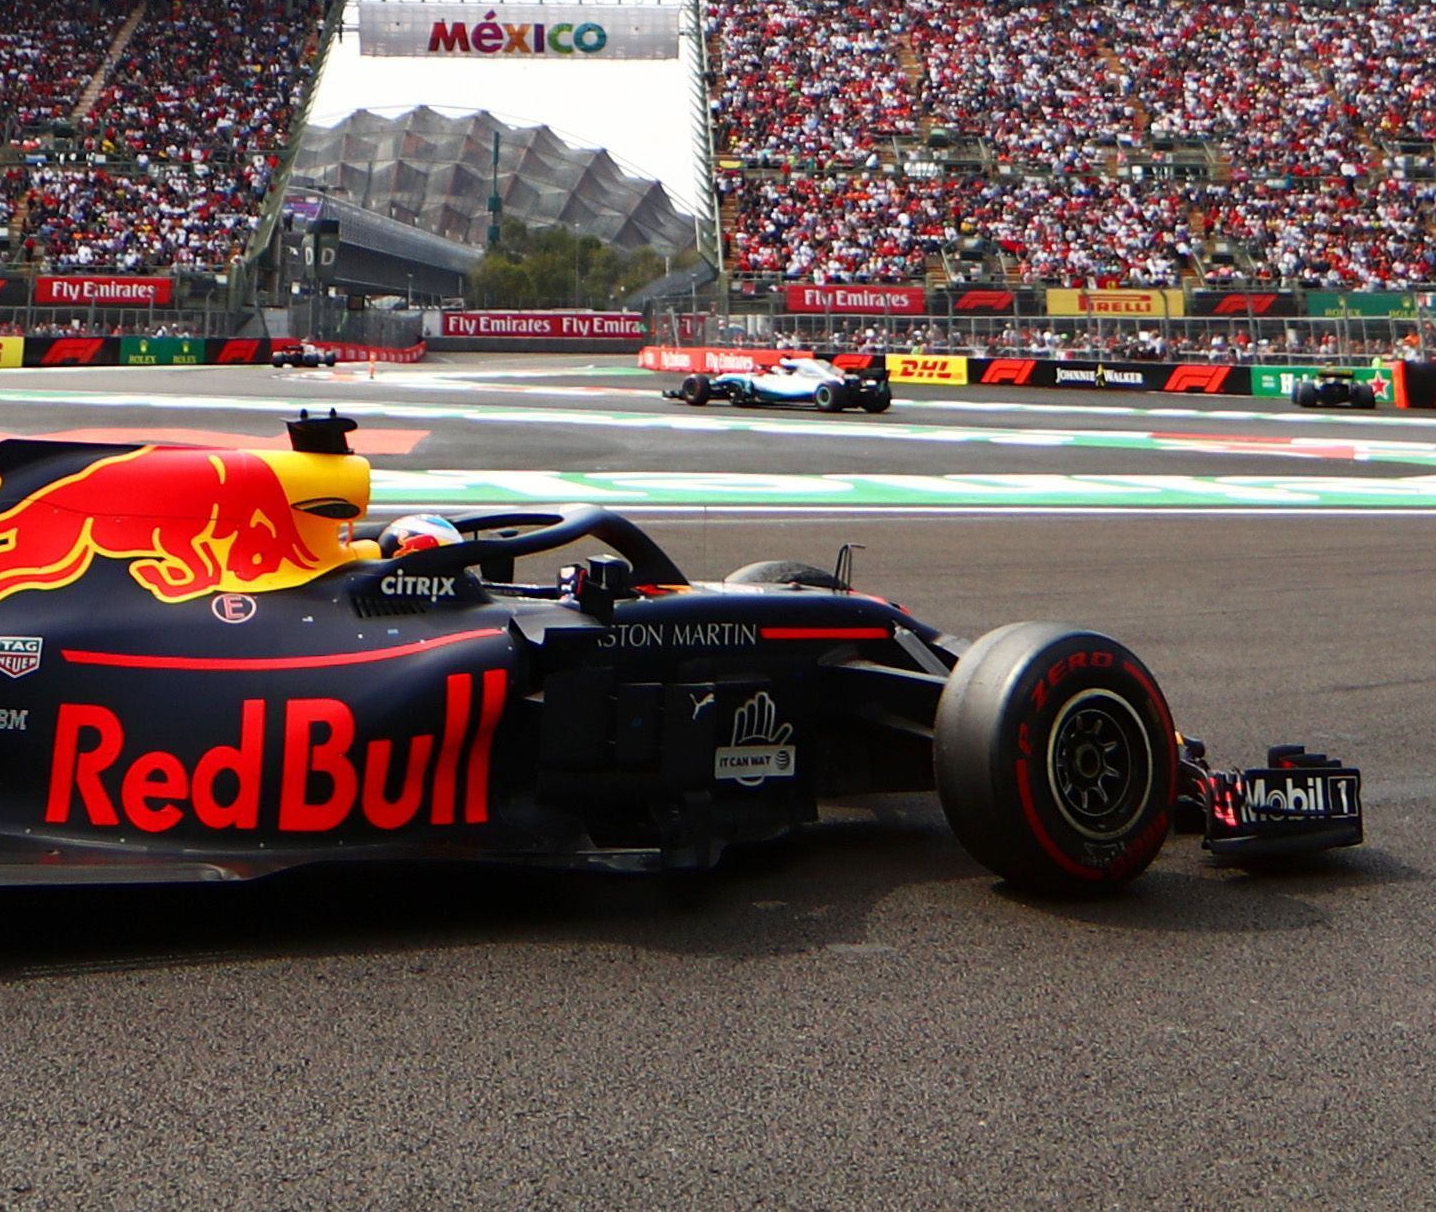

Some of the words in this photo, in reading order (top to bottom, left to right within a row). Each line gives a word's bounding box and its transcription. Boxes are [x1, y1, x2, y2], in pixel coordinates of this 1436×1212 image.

[52, 281, 80, 302] Fly
[82, 281, 156, 299] Emirates
[805, 289, 834, 308] Fly
[835, 289, 910, 307] Emirates
[448, 316, 477, 335] Fly
[479, 316, 552, 333] Emirates
[562, 317, 590, 336] Fly
[593, 317, 642, 334] Emira
[899, 359, 952, 378] DHL
[1055, 368, 1096, 385] JOHNNIE
[1103, 369, 1143, 384] WALKER
[596, 623, 663, 647] STON
[672, 623, 758, 646] MARTIN
[1, 639, 38, 652] TAG
[749, 755, 771, 766] WAT
[1241, 776, 1325, 823] Mobil
